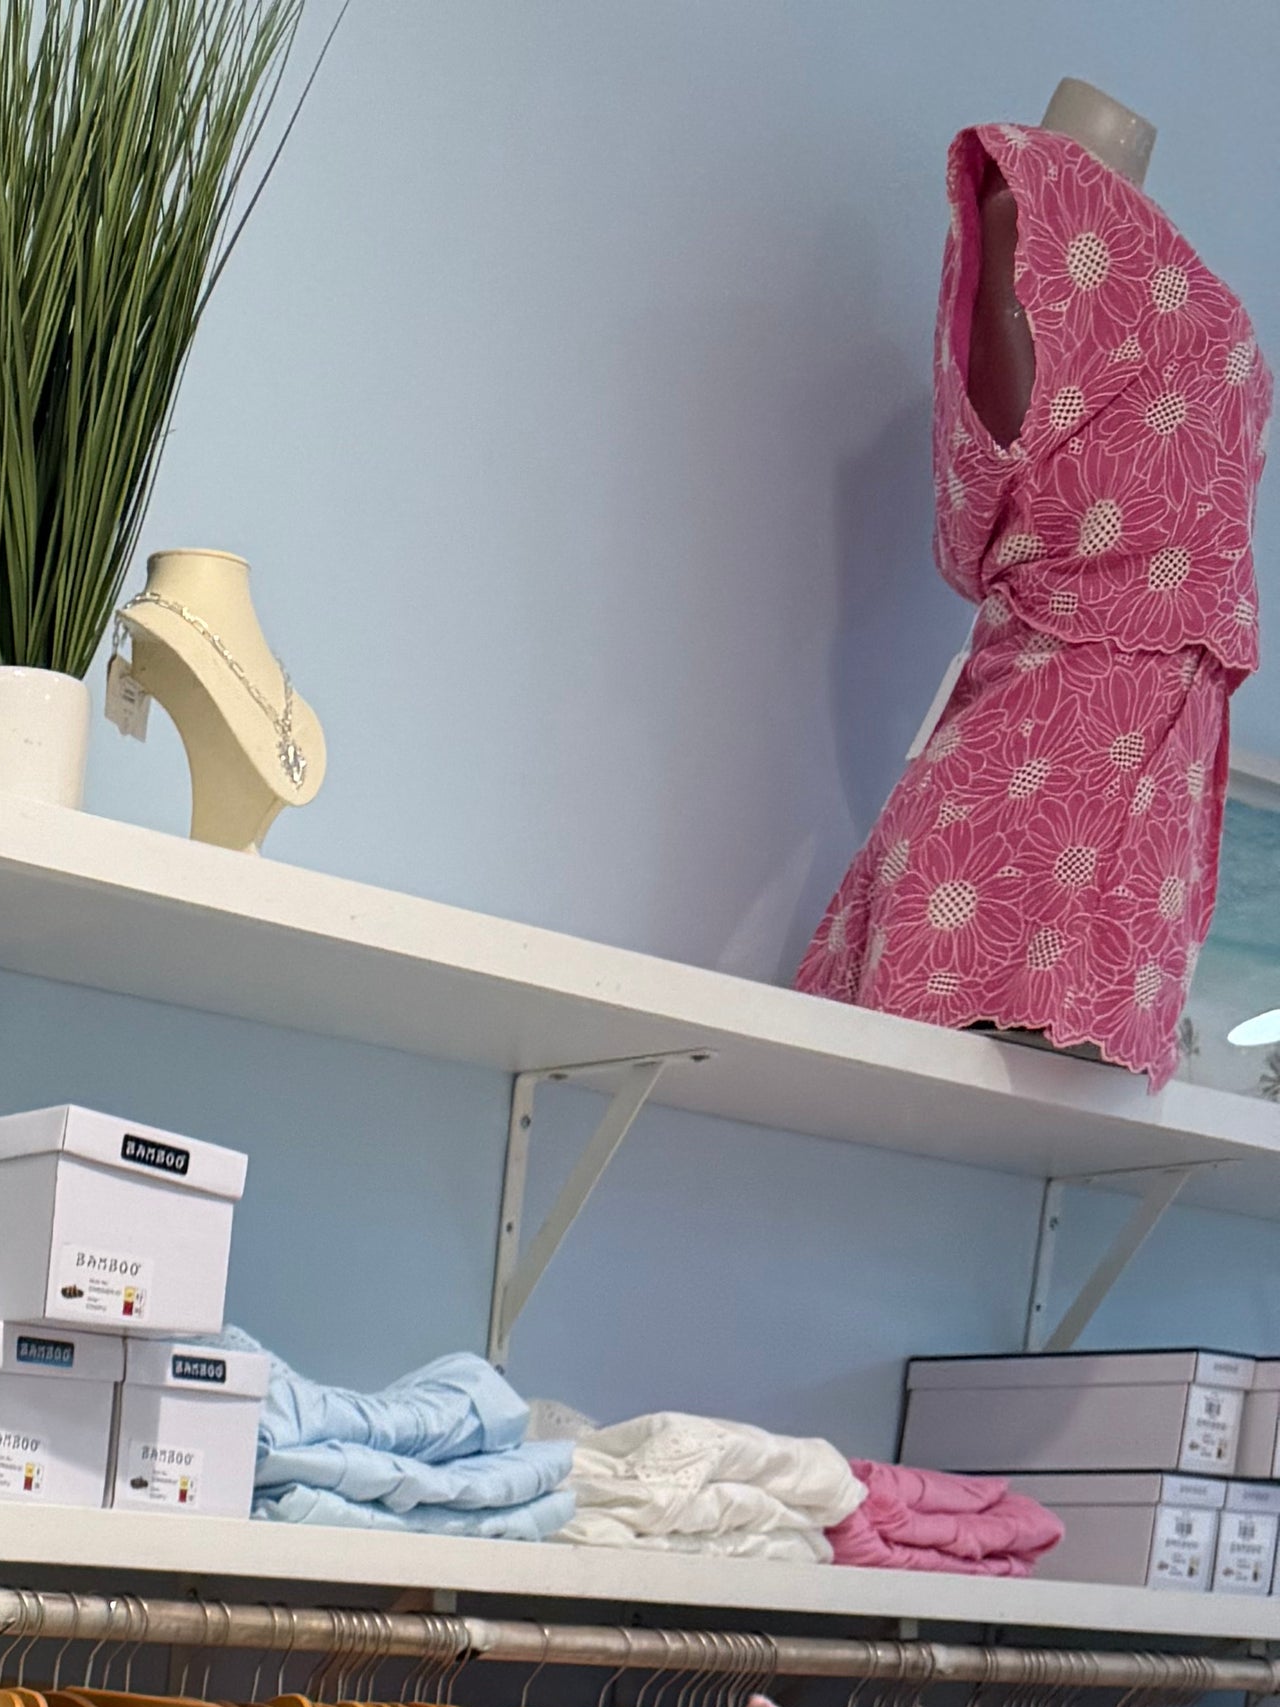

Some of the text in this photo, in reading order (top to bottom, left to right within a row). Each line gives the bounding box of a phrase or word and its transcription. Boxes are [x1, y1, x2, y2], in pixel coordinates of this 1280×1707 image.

[125, 1140, 186, 1170] BAMBOO
[76, 1252, 140, 1276] BAMBOO
[20, 1342, 72, 1362] BAMBOO
[175, 1360, 224, 1379] BAMBOO
[142, 1445, 194, 1466] BAMBOO
